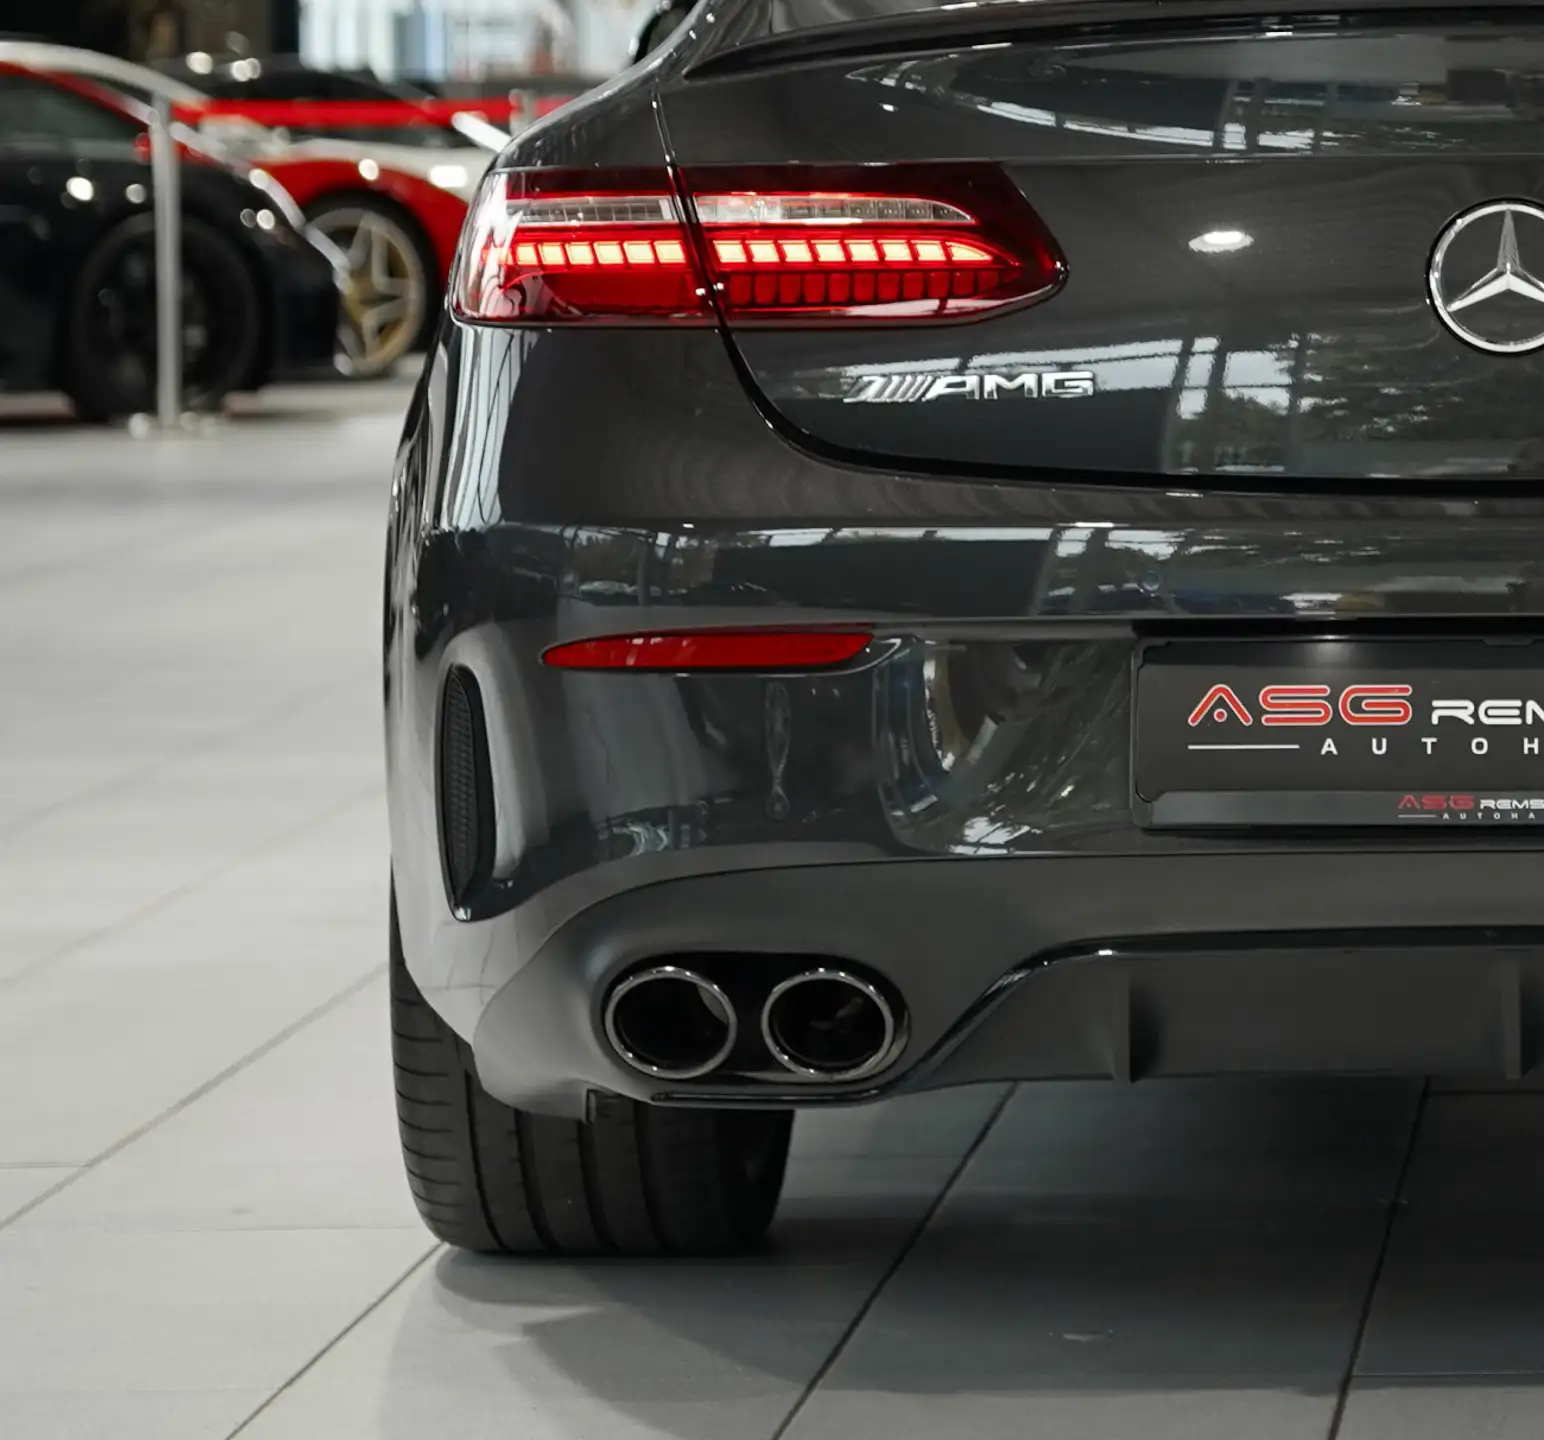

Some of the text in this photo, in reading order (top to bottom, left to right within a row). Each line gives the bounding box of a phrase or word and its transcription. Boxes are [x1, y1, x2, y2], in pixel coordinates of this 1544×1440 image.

[922, 371, 1095, 402] AMG
[1187, 683, 1413, 727] ASG
[1398, 794, 1475, 810] ASG
